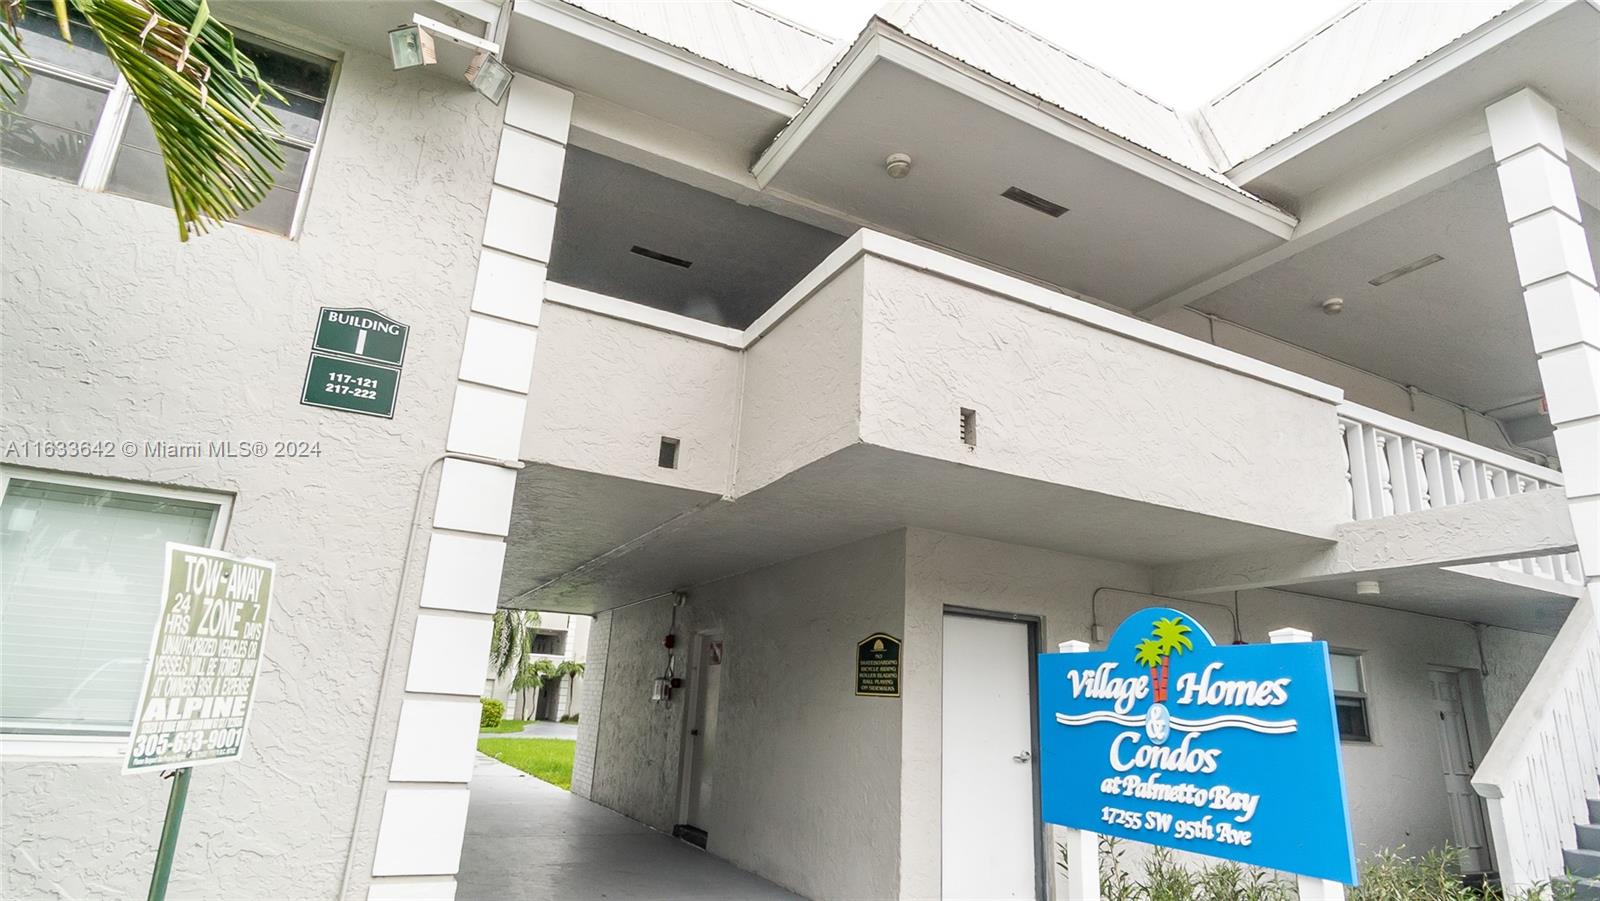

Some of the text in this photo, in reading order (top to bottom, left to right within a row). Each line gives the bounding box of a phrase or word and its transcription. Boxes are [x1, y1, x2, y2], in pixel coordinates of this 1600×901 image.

[328, 311, 400, 335] BUILDING
[325, 383, 377, 400] 217-222
[328, 372, 378, 388] 117-121
[185, 555, 264, 602] TOW-AWAY
[164, 614, 262, 641] HRS DAYS
[171, 592, 261, 637] 24 ZONE 7
[161, 635, 258, 658] UNAUTHORIZED VEHICLES OR
[154, 655, 189, 676] VESSELS
[190, 657, 207, 675] WILL
[206, 658, 219, 676] BE
[218, 658, 241, 676] TOWED
[151, 677, 165, 697] AT
[195, 677, 215, 696] RISK
[221, 677, 251, 696] EXPENSE
[1067, 662, 1292, 715] Village Homes
[142, 696, 249, 721] ALPINE
[1148, 706, 1167, 740] &
[133, 728, 243, 758] 305-633-9001
[1109, 731, 1222, 774] Condos
[1100, 772, 1260, 823] at Palmetto Bay
[1101, 806, 1252, 846] 17255 SW 95th Ave
